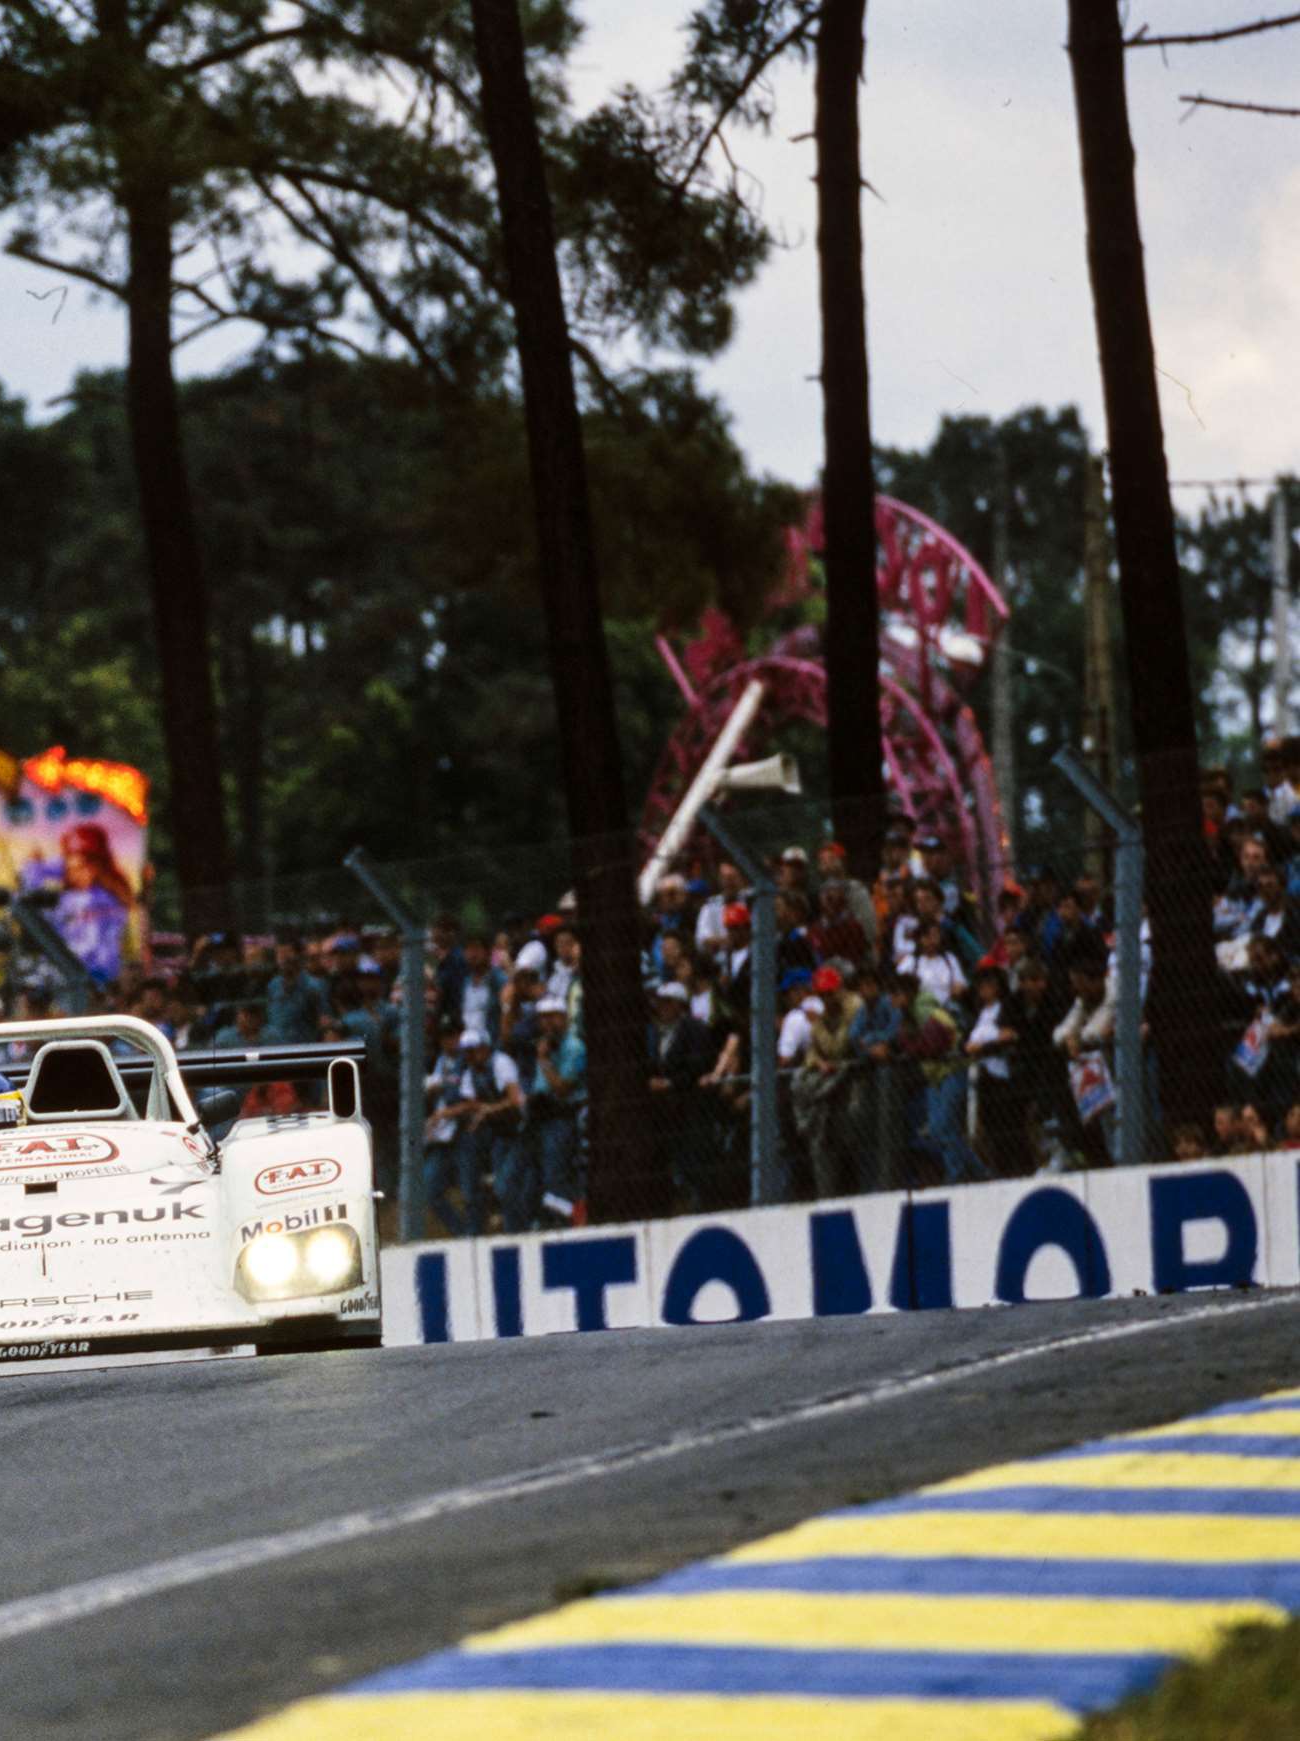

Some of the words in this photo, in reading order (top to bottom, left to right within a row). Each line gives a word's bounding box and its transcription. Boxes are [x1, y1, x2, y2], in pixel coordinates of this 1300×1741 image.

[94, 1236, 118, 1246] no
[126, 1230, 212, 1244] antenna
[240, 1207, 319, 1243] Mobil
